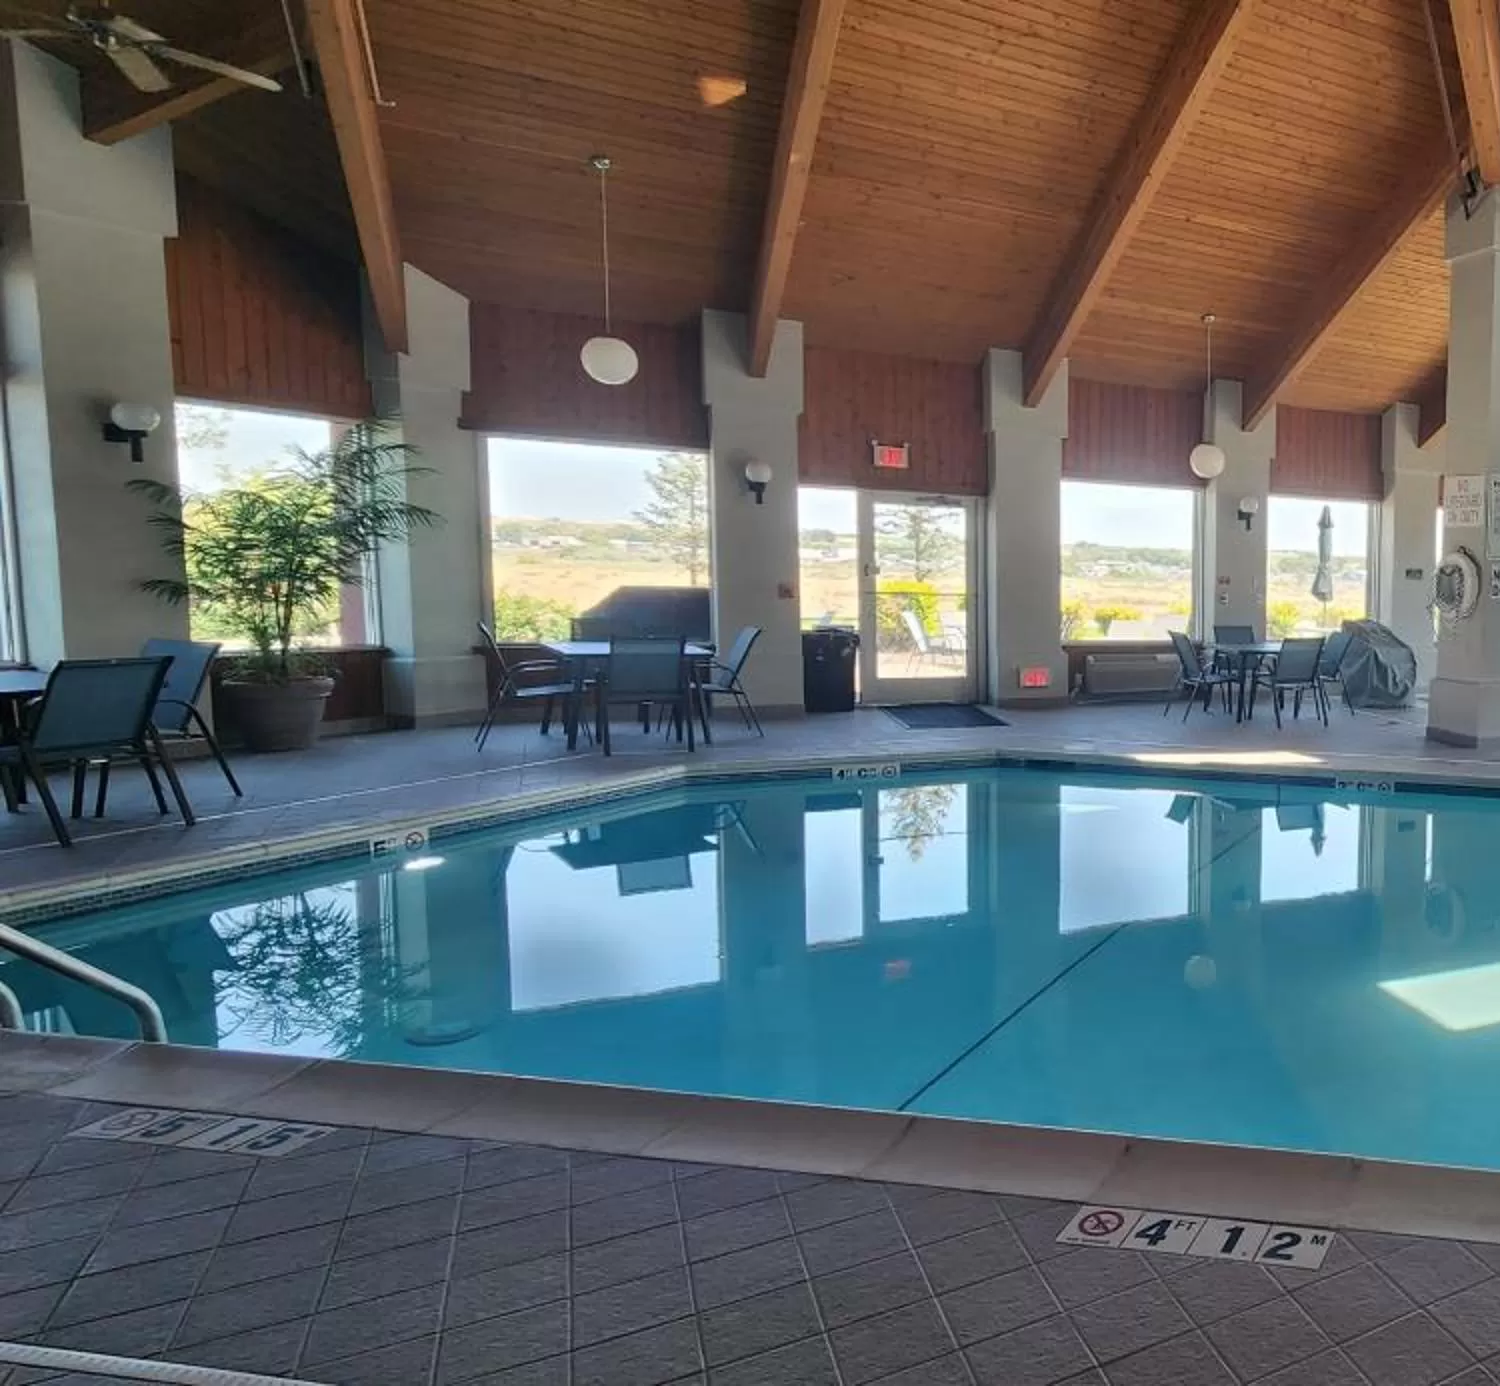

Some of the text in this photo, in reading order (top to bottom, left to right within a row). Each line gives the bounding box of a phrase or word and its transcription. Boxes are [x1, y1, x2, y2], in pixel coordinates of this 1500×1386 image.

[1134, 1218, 1173, 1247] 4
[1174, 1220, 1197, 1232] FT
[1309, 1233, 1327, 1247] M
